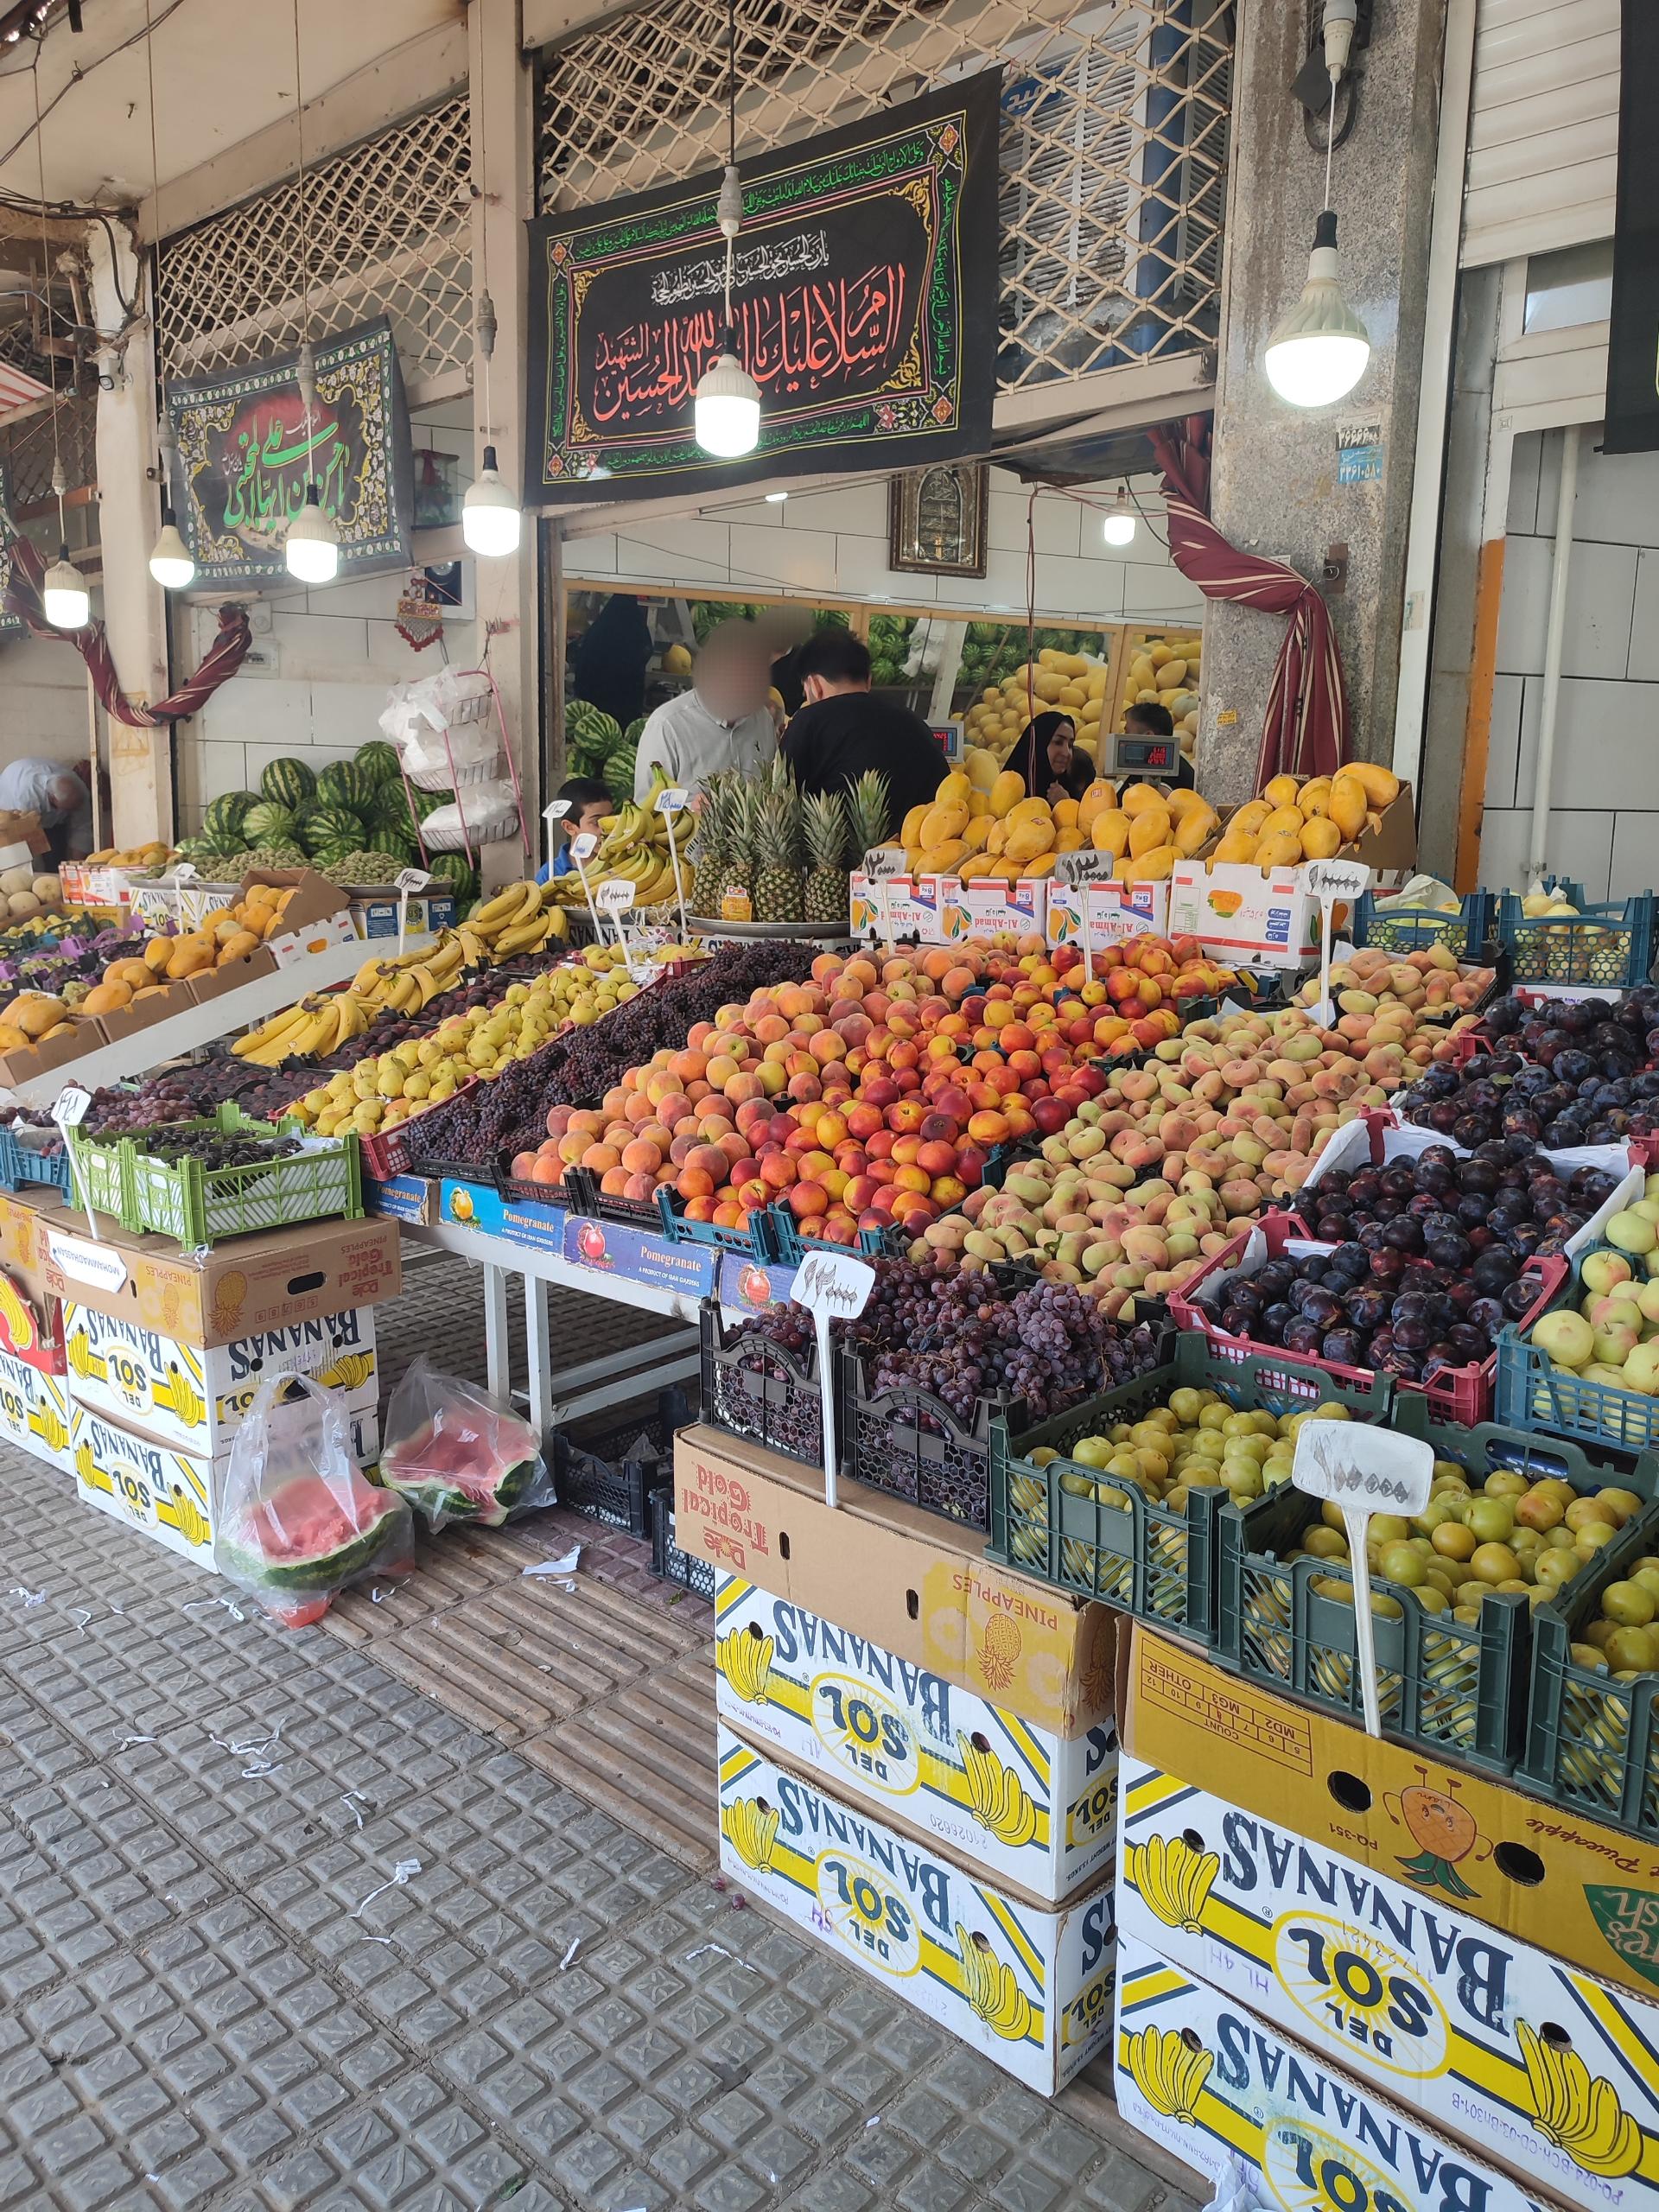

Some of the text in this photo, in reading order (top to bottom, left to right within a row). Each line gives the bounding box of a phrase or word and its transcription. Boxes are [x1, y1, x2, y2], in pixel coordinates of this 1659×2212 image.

[975, 918, 1018, 929] Al-Ahmad
[1090, 921, 1134, 934] Al-Ahma
[503, 1209, 554, 1232] Pomegranate
[340, 1236, 387, 1255] PINEAPPLES
[346, 1249, 383, 1269] Gold
[640, 1245, 702, 1272] Pomegranate
[46, 1268, 65, 1293] Dole
[145, 1265, 191, 1287] PINEAPPLES
[339, 1261, 394, 1287] Tropical
[352, 1279, 378, 1297] Dole
[86, 1308, 164, 1375] BANANAS
[228, 1308, 361, 1382] BANANAS
[109, 1354, 147, 1392] SOL
[122, 1390, 142, 1409] DEL
[225, 1392, 255, 1412] OL
[91, 1420, 168, 1493] BANANAS
[112, 1471, 151, 1509] SOL
[696, 1464, 752, 1515] Gold
[129, 1505, 148, 1523] DEL
[682, 1488, 769, 1556] Tropical
[703, 1527, 747, 1571] Dole
[952, 1573, 1058, 1631] PINEAPPLES
[772, 1599, 954, 1748] BANANAS
[1147, 1675, 1156, 1687] 12
[1148, 1660, 1192, 1691] OTHER
[1171, 1688, 1181, 1700] 10
[1211, 1693, 1241, 1715] MG3
[818, 1686, 909, 1761] SOL
[1203, 1719, 1240, 1741] COUNT
[1264, 1718, 1297, 1740] MD2
[845, 1744, 888, 1782] DEL
[1088, 1810, 1110, 1834] DEL
[1328, 1821, 1378, 1851] PQ-351
[777, 1777, 953, 1937] BANANAS
[1524, 1818, 1640, 1874] Pineapple
[824, 1860, 911, 1942] SOL
[849, 1919, 889, 1961] DEL
[1222, 1811, 1515, 2039] BANANAS
[1287, 1928, 1433, 2038] SOL
[1084, 2005, 1104, 2029] DEL
[1325, 2001, 1394, 2059] DEL
[1217, 2012, 1494, 2212] BANANAS
